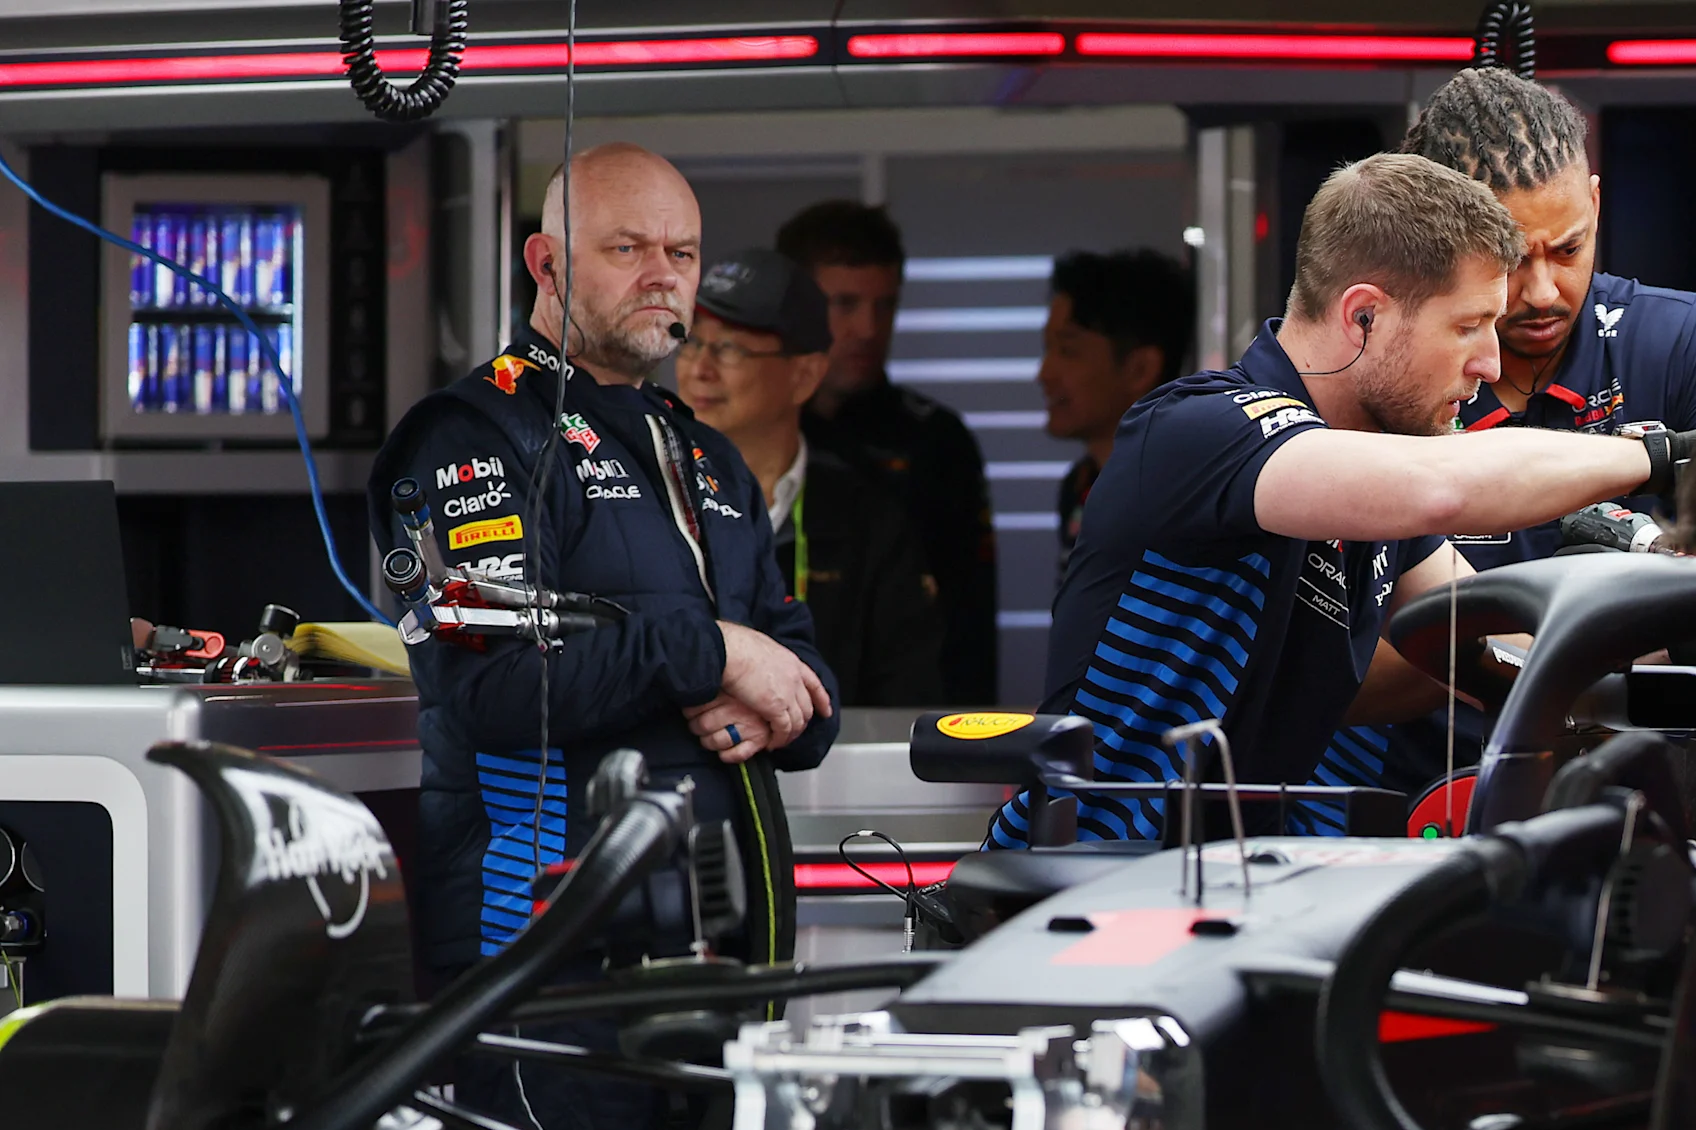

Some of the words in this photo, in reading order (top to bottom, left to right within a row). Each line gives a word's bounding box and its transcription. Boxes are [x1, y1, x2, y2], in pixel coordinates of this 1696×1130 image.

[436, 457, 505, 489] Mobil
[444, 484, 508, 518] Claro
[455, 520, 516, 545] PIRELLI
[1312, 595, 1341, 616] MATT
